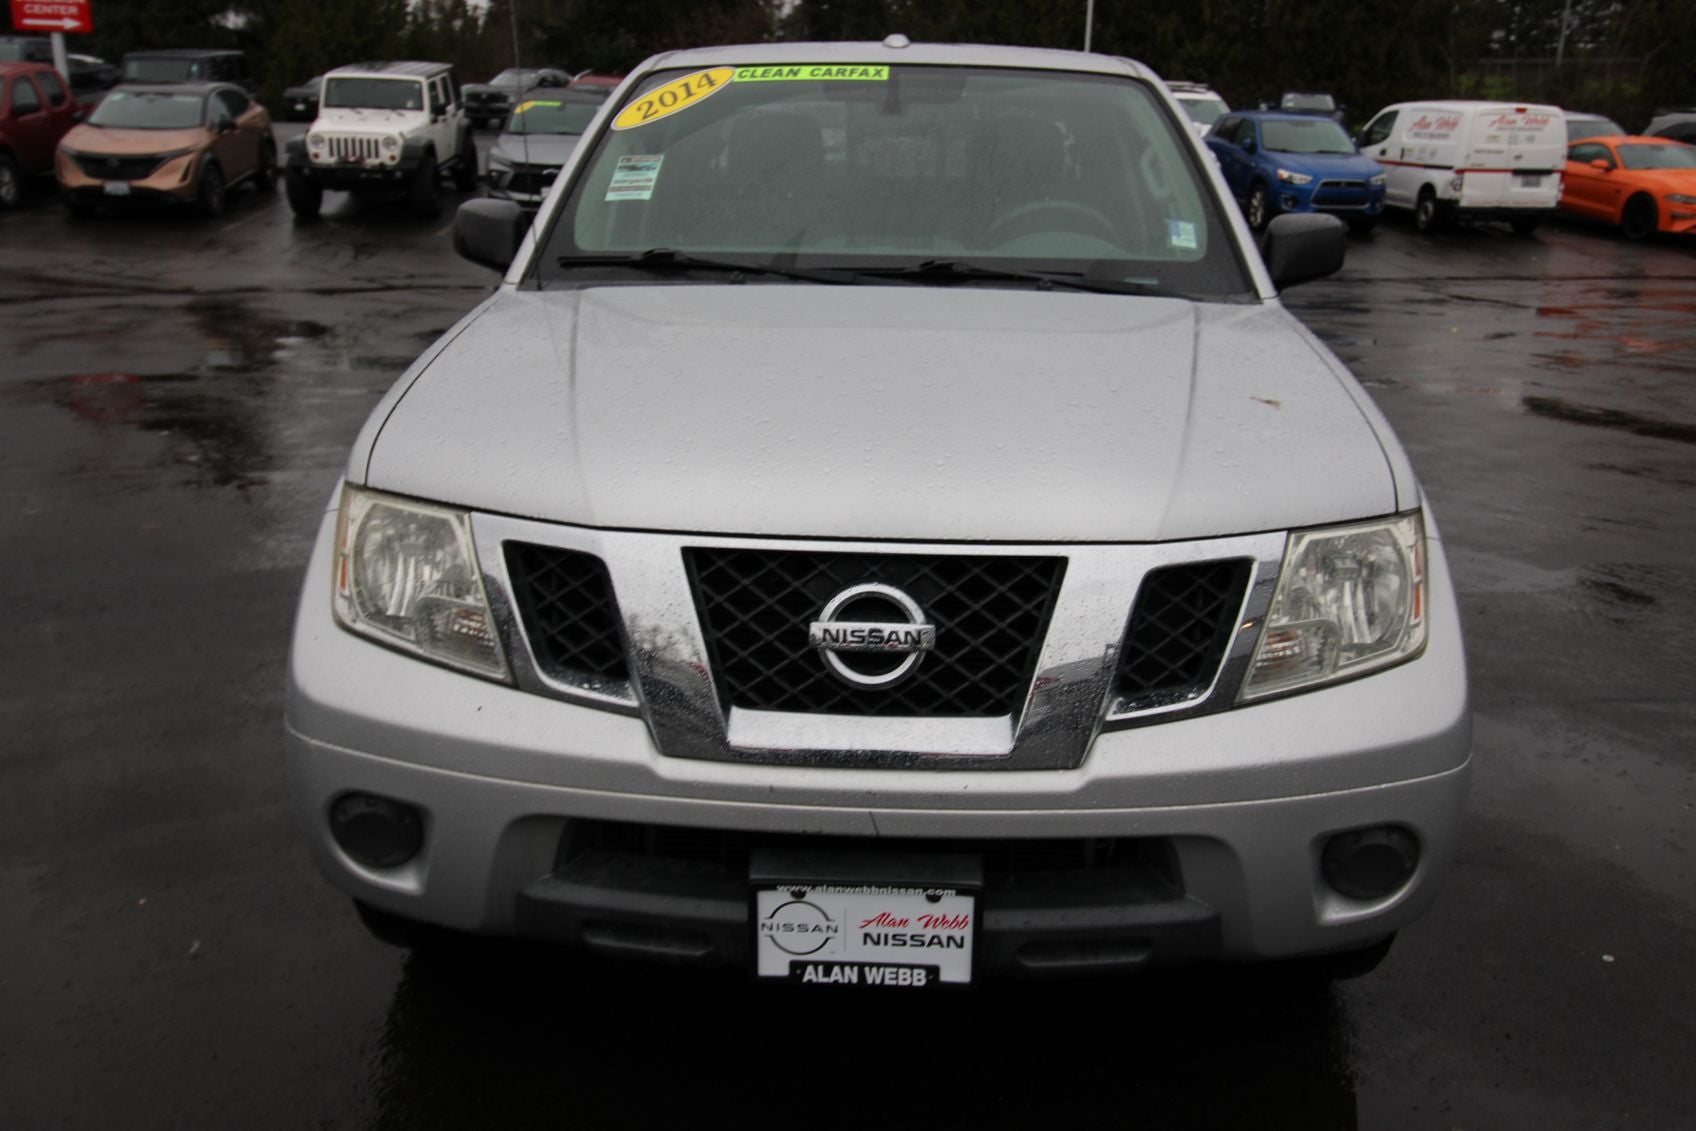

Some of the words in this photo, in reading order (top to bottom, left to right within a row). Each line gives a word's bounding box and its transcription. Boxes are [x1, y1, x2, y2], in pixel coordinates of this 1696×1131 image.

[23, 3, 79, 15] CENTER
[738, 67, 800, 79] CLEAN
[810, 67, 884, 78] CARFAX
[636, 72, 718, 121] 2014
[822, 628, 921, 644] NISSAN
[776, 884, 956, 897] www.alanwebbnissan.com
[761, 922, 838, 934] NISSAN
[859, 911, 910, 929] Alan
[916, 912, 970, 930] Webb
[863, 932, 965, 949] NISSAN
[802, 964, 858, 984] ALAN
[864, 965, 927, 987] WEBB
